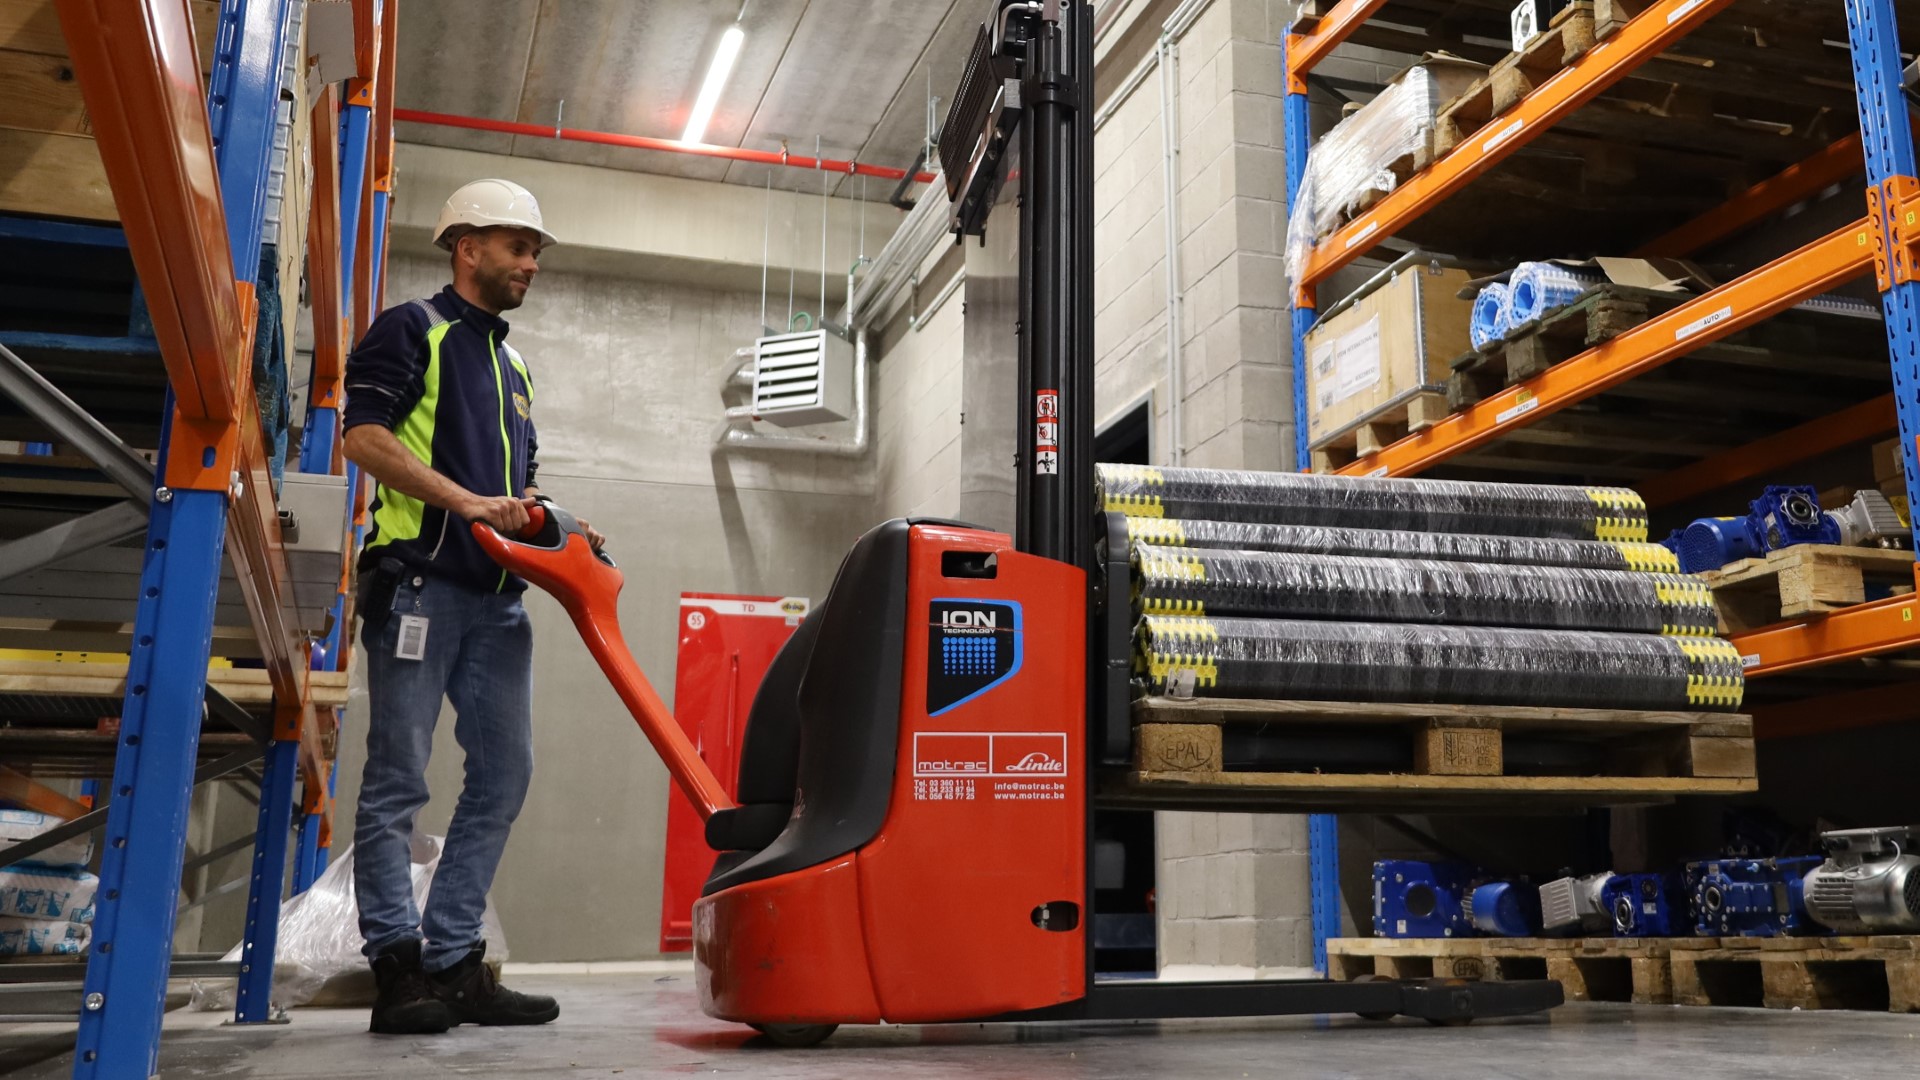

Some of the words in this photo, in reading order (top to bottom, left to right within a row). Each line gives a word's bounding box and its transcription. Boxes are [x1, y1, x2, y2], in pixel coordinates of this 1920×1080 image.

[742, 603, 755, 612] TD
[1904, 610, 1909, 619] A
[942, 611, 996, 628] ION
[1166, 741, 1204, 761] EPAL
[918, 759, 987, 771] motrac
[1005, 752, 1062, 771] Linde
[914, 779, 927, 787] Tel.
[994, 782, 1065, 790] info@motrac.be
[994, 792, 1065, 800] www.motrac.be
